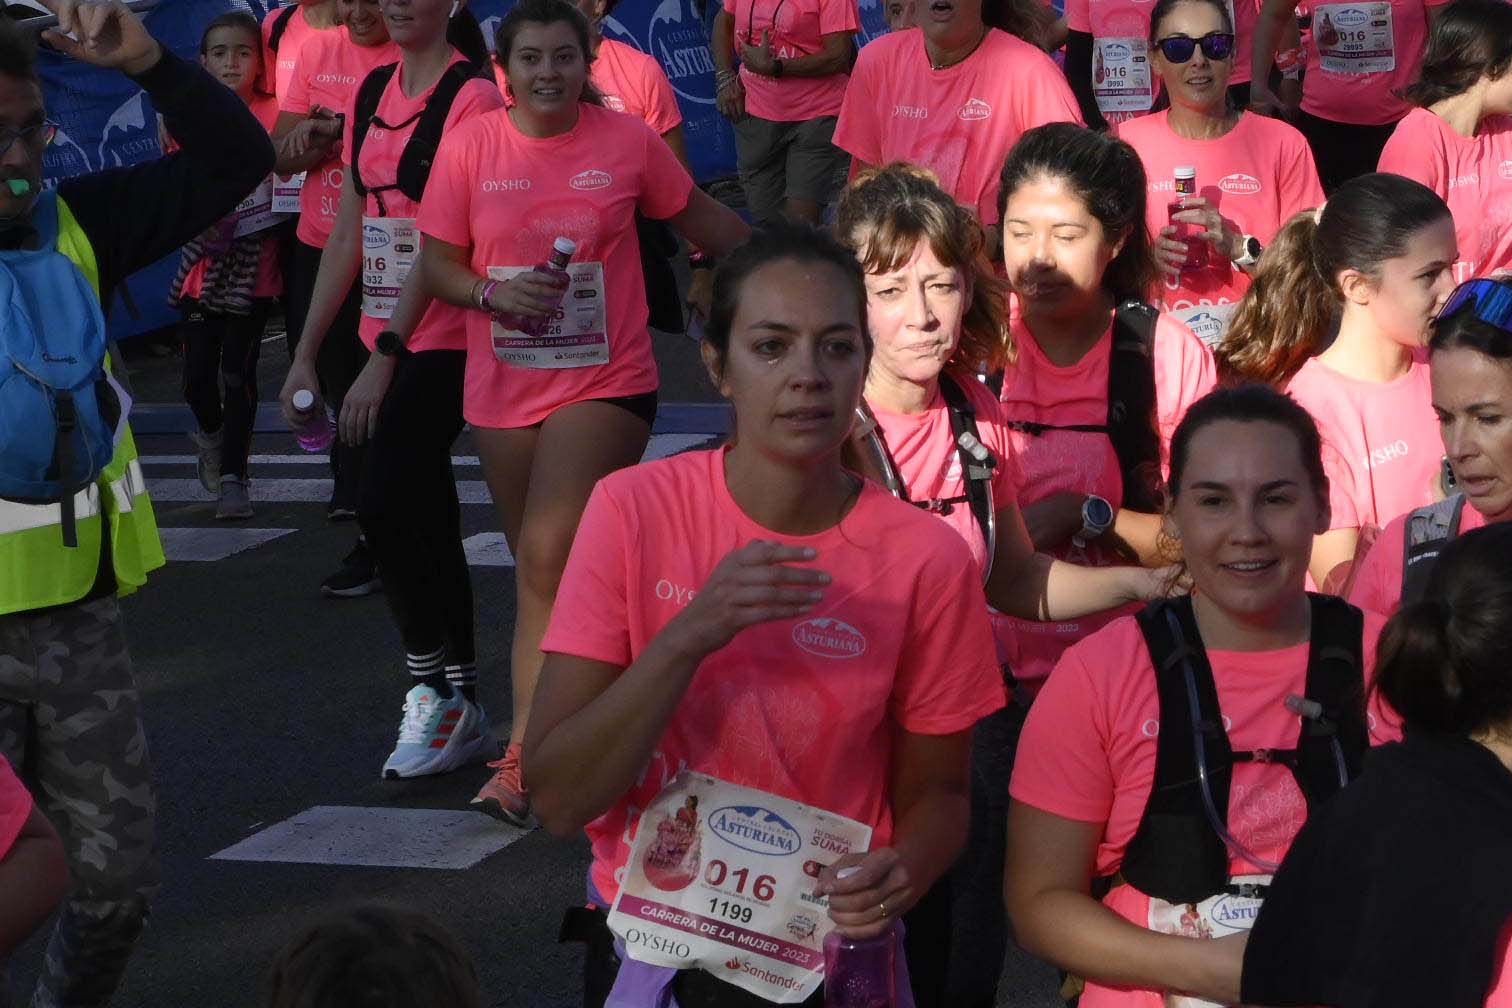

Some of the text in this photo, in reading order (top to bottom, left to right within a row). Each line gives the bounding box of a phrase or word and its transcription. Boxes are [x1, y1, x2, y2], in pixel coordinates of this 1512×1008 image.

[1340, 31, 1365, 41] 016
[316, 73, 356, 85] OYSHO
[1104, 66, 1127, 78] 016
[483, 179, 531, 192] OYSHO
[1222, 181, 1258, 191] ASTURIANA
[564, 351, 599, 360] Santander
[797, 629, 862, 653] ASTURIANA
[714, 813, 793, 852] ASTURIANA
[811, 836, 849, 854] SUMA
[704, 859, 777, 902] 016
[709, 897, 753, 924] 1199
[626, 928, 691, 959] OYSHO
[640, 905, 810, 964] CARRERA DE LA MUJER 2023
[743, 961, 805, 991] Santander
